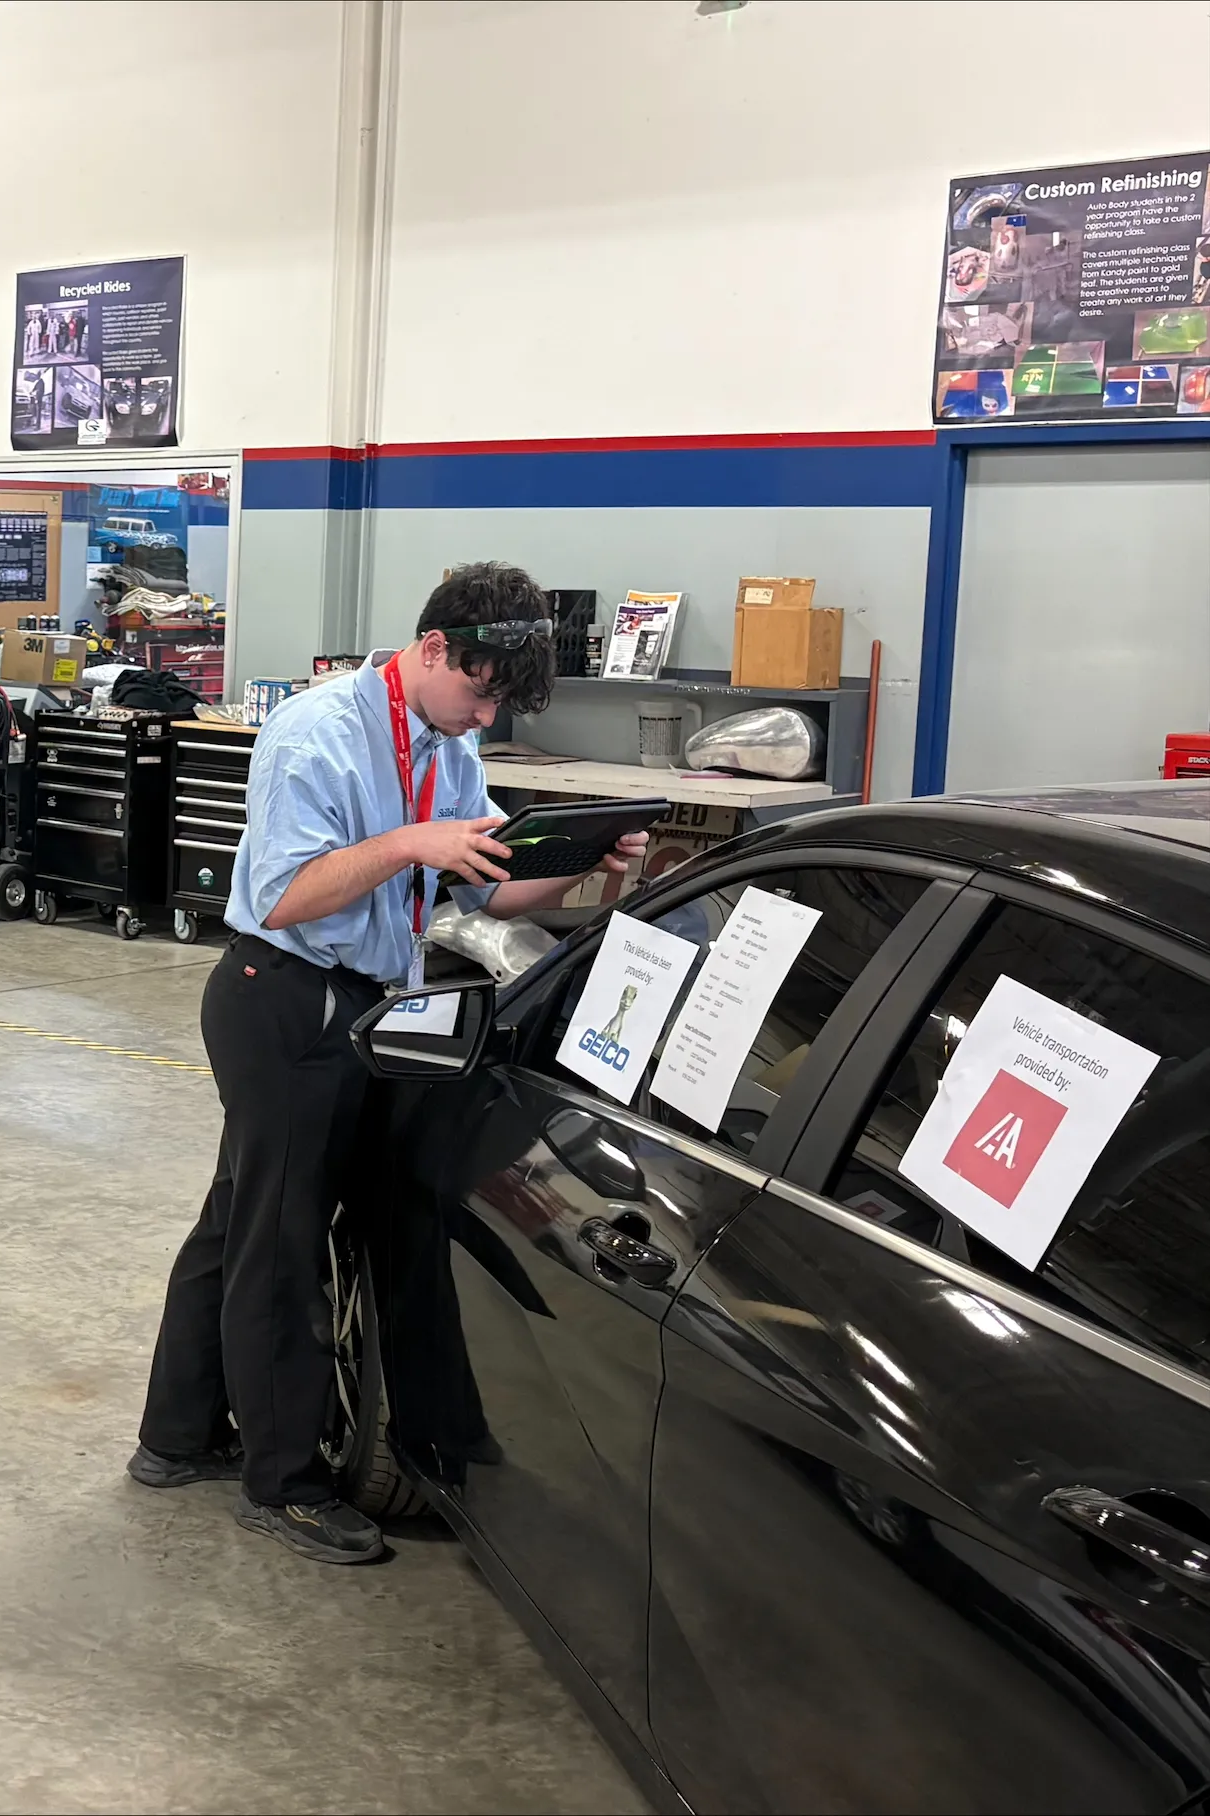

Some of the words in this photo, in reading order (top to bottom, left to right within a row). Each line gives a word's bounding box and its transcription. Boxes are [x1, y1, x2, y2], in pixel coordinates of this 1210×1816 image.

[1025, 181, 1095, 200] Custom
[1101, 169, 1202, 192] Refinishing
[1108, 201, 1129, 209] Body
[1130, 196, 1163, 206] students
[1165, 195, 1172, 203] in
[1174, 194, 1188, 202] the
[1086, 213, 1103, 221] year
[1105, 209, 1140, 219] program
[1142, 207, 1163, 215] have
[1165, 205, 1178, 213] the
[1085, 219, 1131, 230] opportunity
[1133, 218, 1140, 226] to
[1143, 216, 1161, 224] take
[1170, 213, 1201, 222] custom
[1084, 228, 1122, 239] refinishing
[1098, 249, 1127, 258] custom
[1128, 246, 1168, 256] refinishing
[1170, 244, 1190, 252] class
[1109, 258, 1140, 267] multiple
[1142, 254, 1188, 264] techniques
[1081, 270, 1099, 278] from
[1101, 268, 1126, 277] Kandy
[1127, 266, 1148, 275] paint
[1161, 264, 1180, 273] gold
[1099, 278, 1113, 286] The
[1115, 276, 1148, 285] students
[1149, 275, 1163, 283] are
[1165, 273, 1188, 283] given
[60, 282, 101, 298] Recycled
[104, 280, 131, 293] Rides
[1080, 289, 1096, 297] free
[1097, 287, 1129, 296] creative
[1131, 285, 1158, 293] means
[1160, 284, 1169, 292] to
[1079, 299, 1105, 307] create
[1107, 298, 1122, 306] any
[1123, 295, 1143, 304] work
[1168, 293, 1187, 302] they
[1079, 309, 1104, 317] desire.
[24, 637, 43, 653] 3M
[623, 940, 635, 954] This
[578, 1028, 630, 1071] GEICO
[1012, 1016, 1043, 1043] Vehicle
[1042, 1034, 1108, 1079] transportation
[1013, 1053, 1058, 1082] provided
[1054, 1071, 1071, 1092] by:
